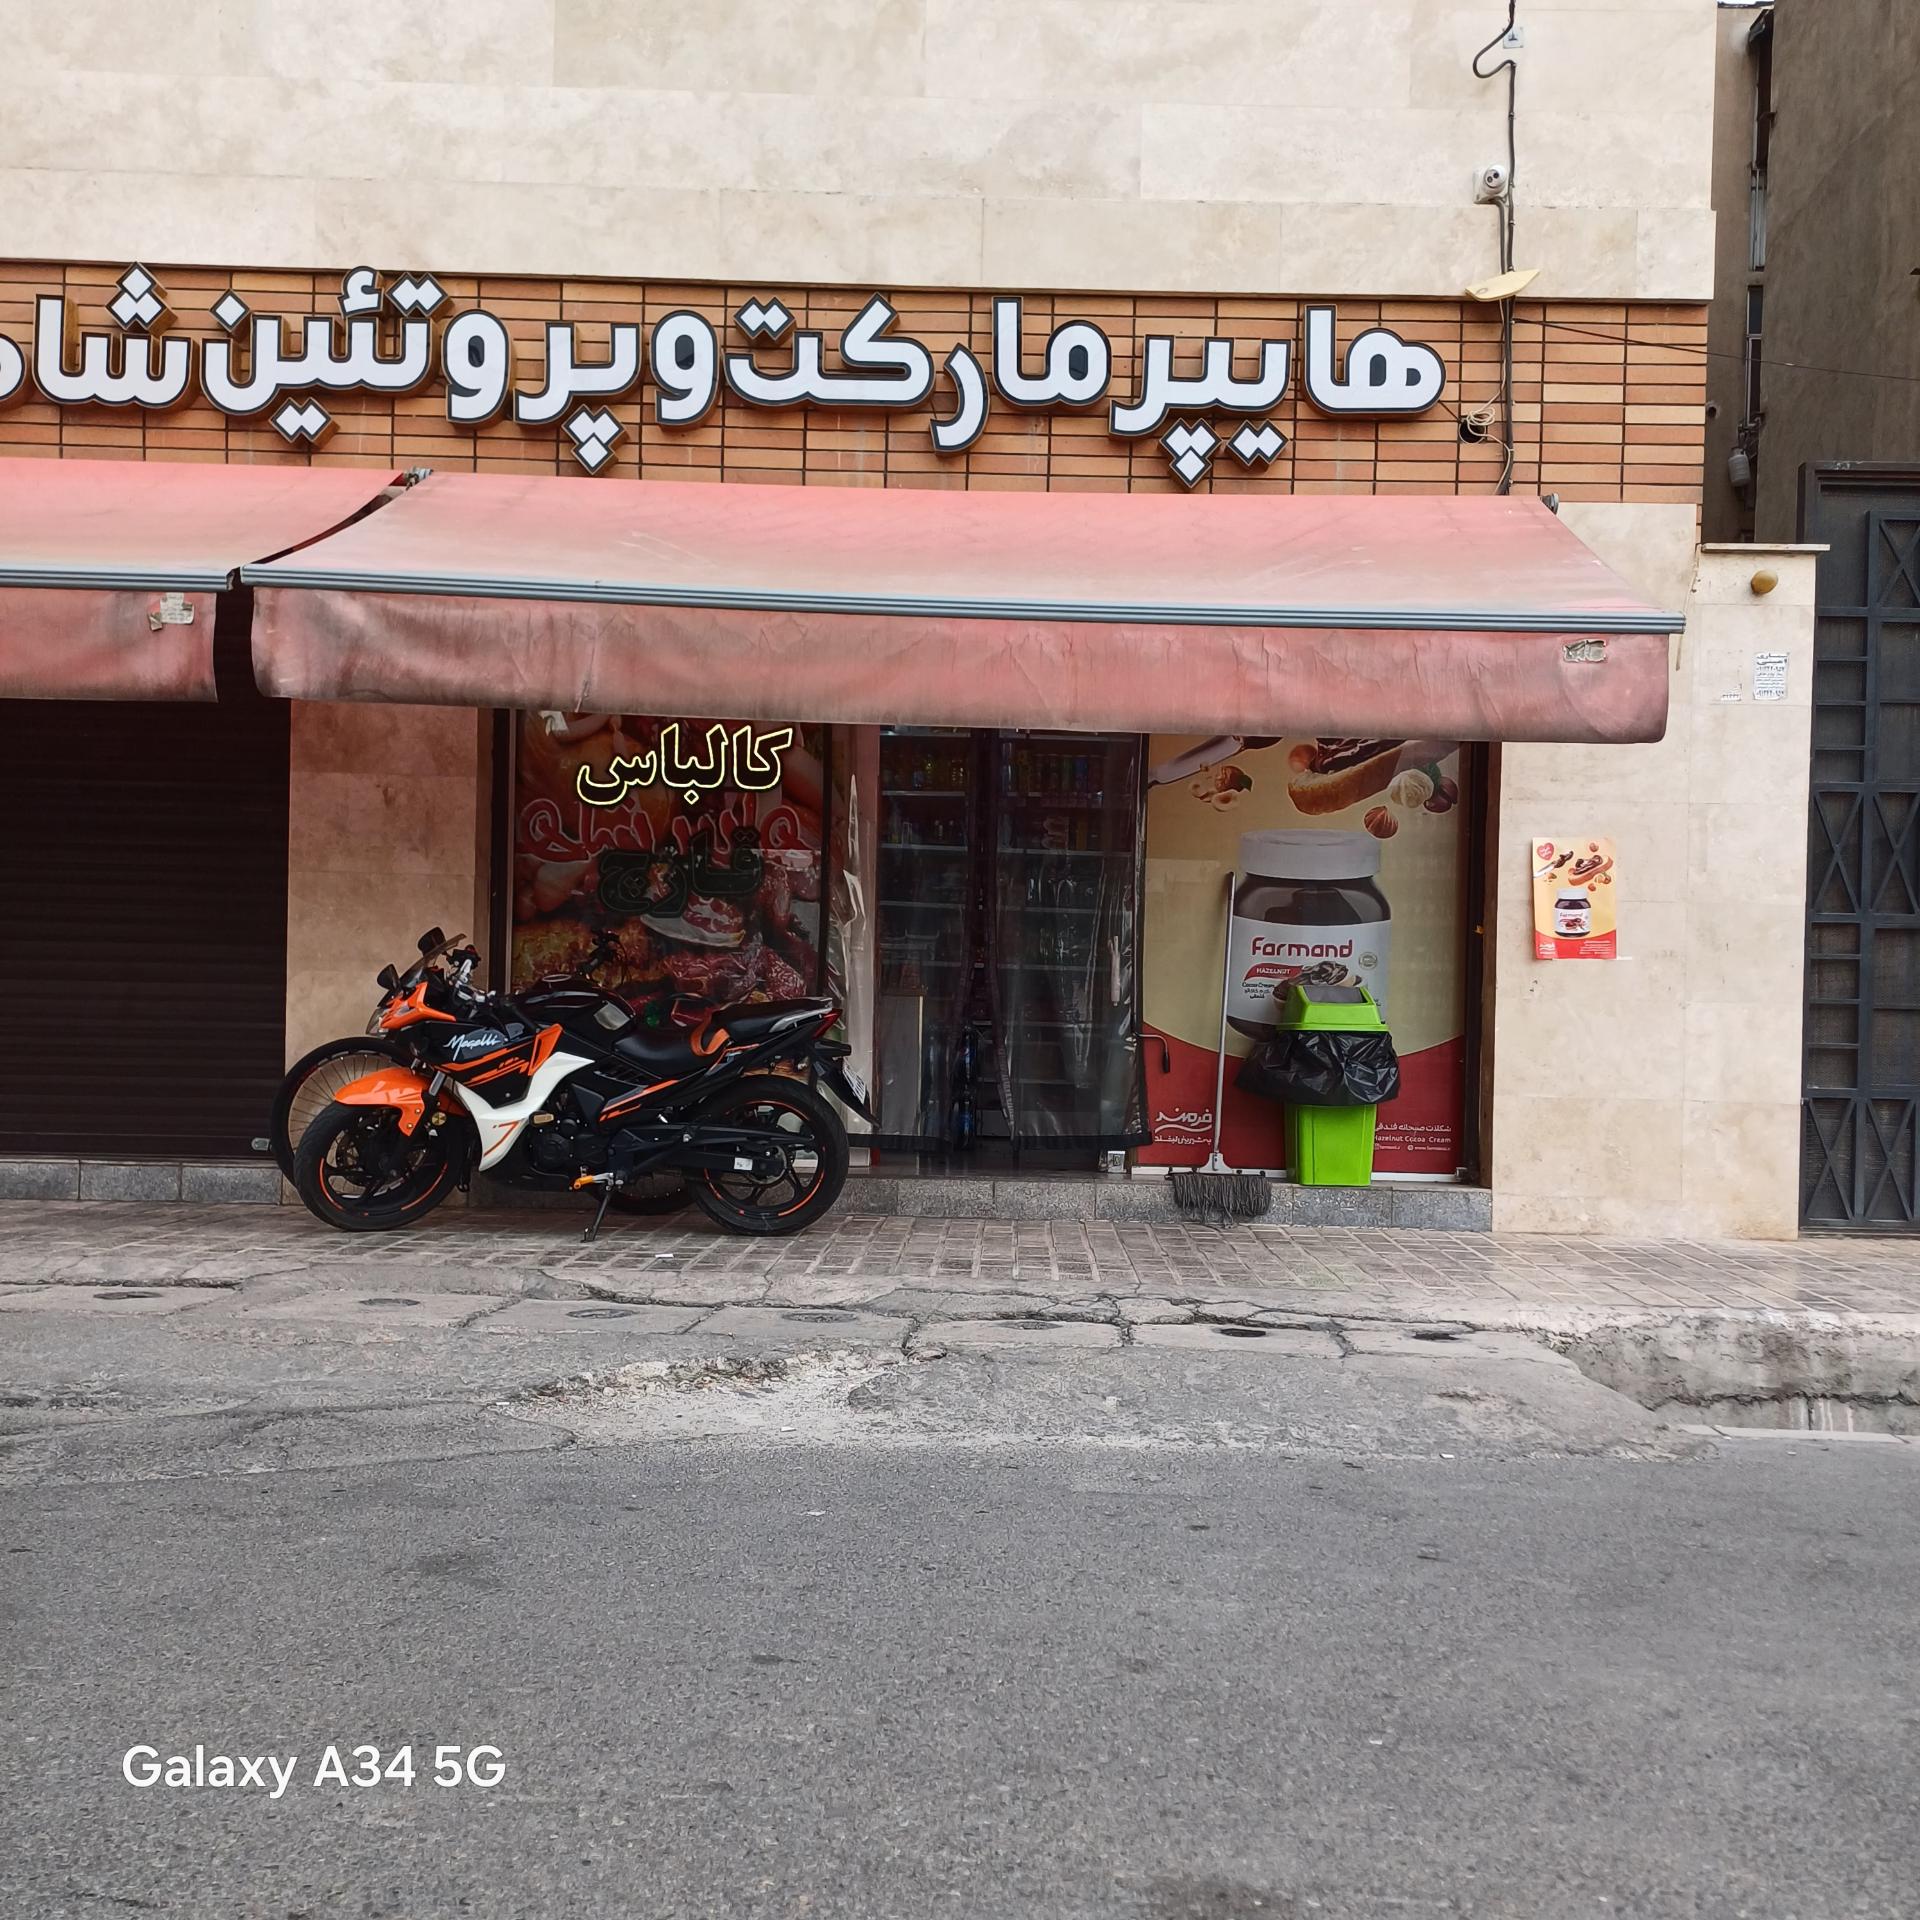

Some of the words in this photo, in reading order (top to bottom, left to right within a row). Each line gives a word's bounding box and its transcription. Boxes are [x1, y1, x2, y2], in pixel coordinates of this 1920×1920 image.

[576, 722, 793, 806] کالباس
[1155, 1107, 1213, 1127] فرمند
[1425, 1124, 1452, 1132] شکلات
[1404, 1135, 1426, 1143] Cocoa
